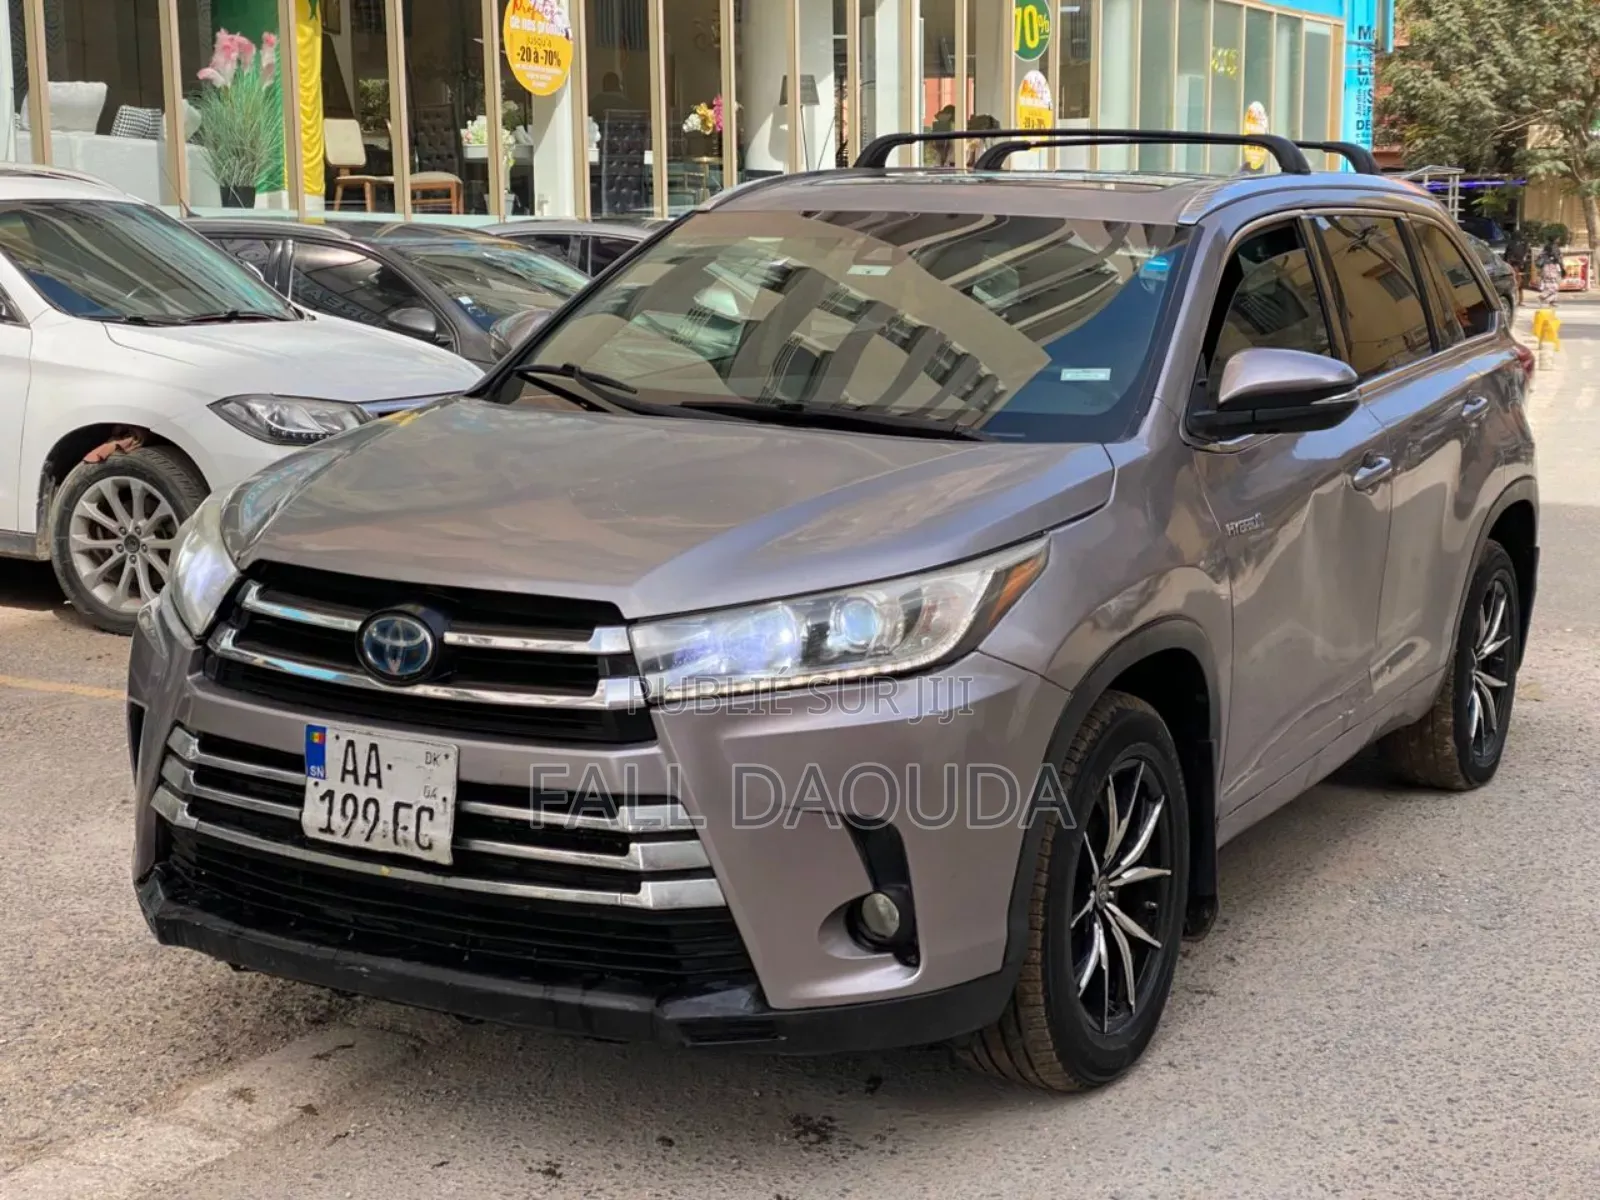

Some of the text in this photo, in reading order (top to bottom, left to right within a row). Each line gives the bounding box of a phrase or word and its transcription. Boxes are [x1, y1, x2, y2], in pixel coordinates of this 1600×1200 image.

[516, 45, 532, 63] -20
[540, 49, 562, 67] -70%
[424, 750, 441, 767] DK
[309, 765, 325, 779] SN
